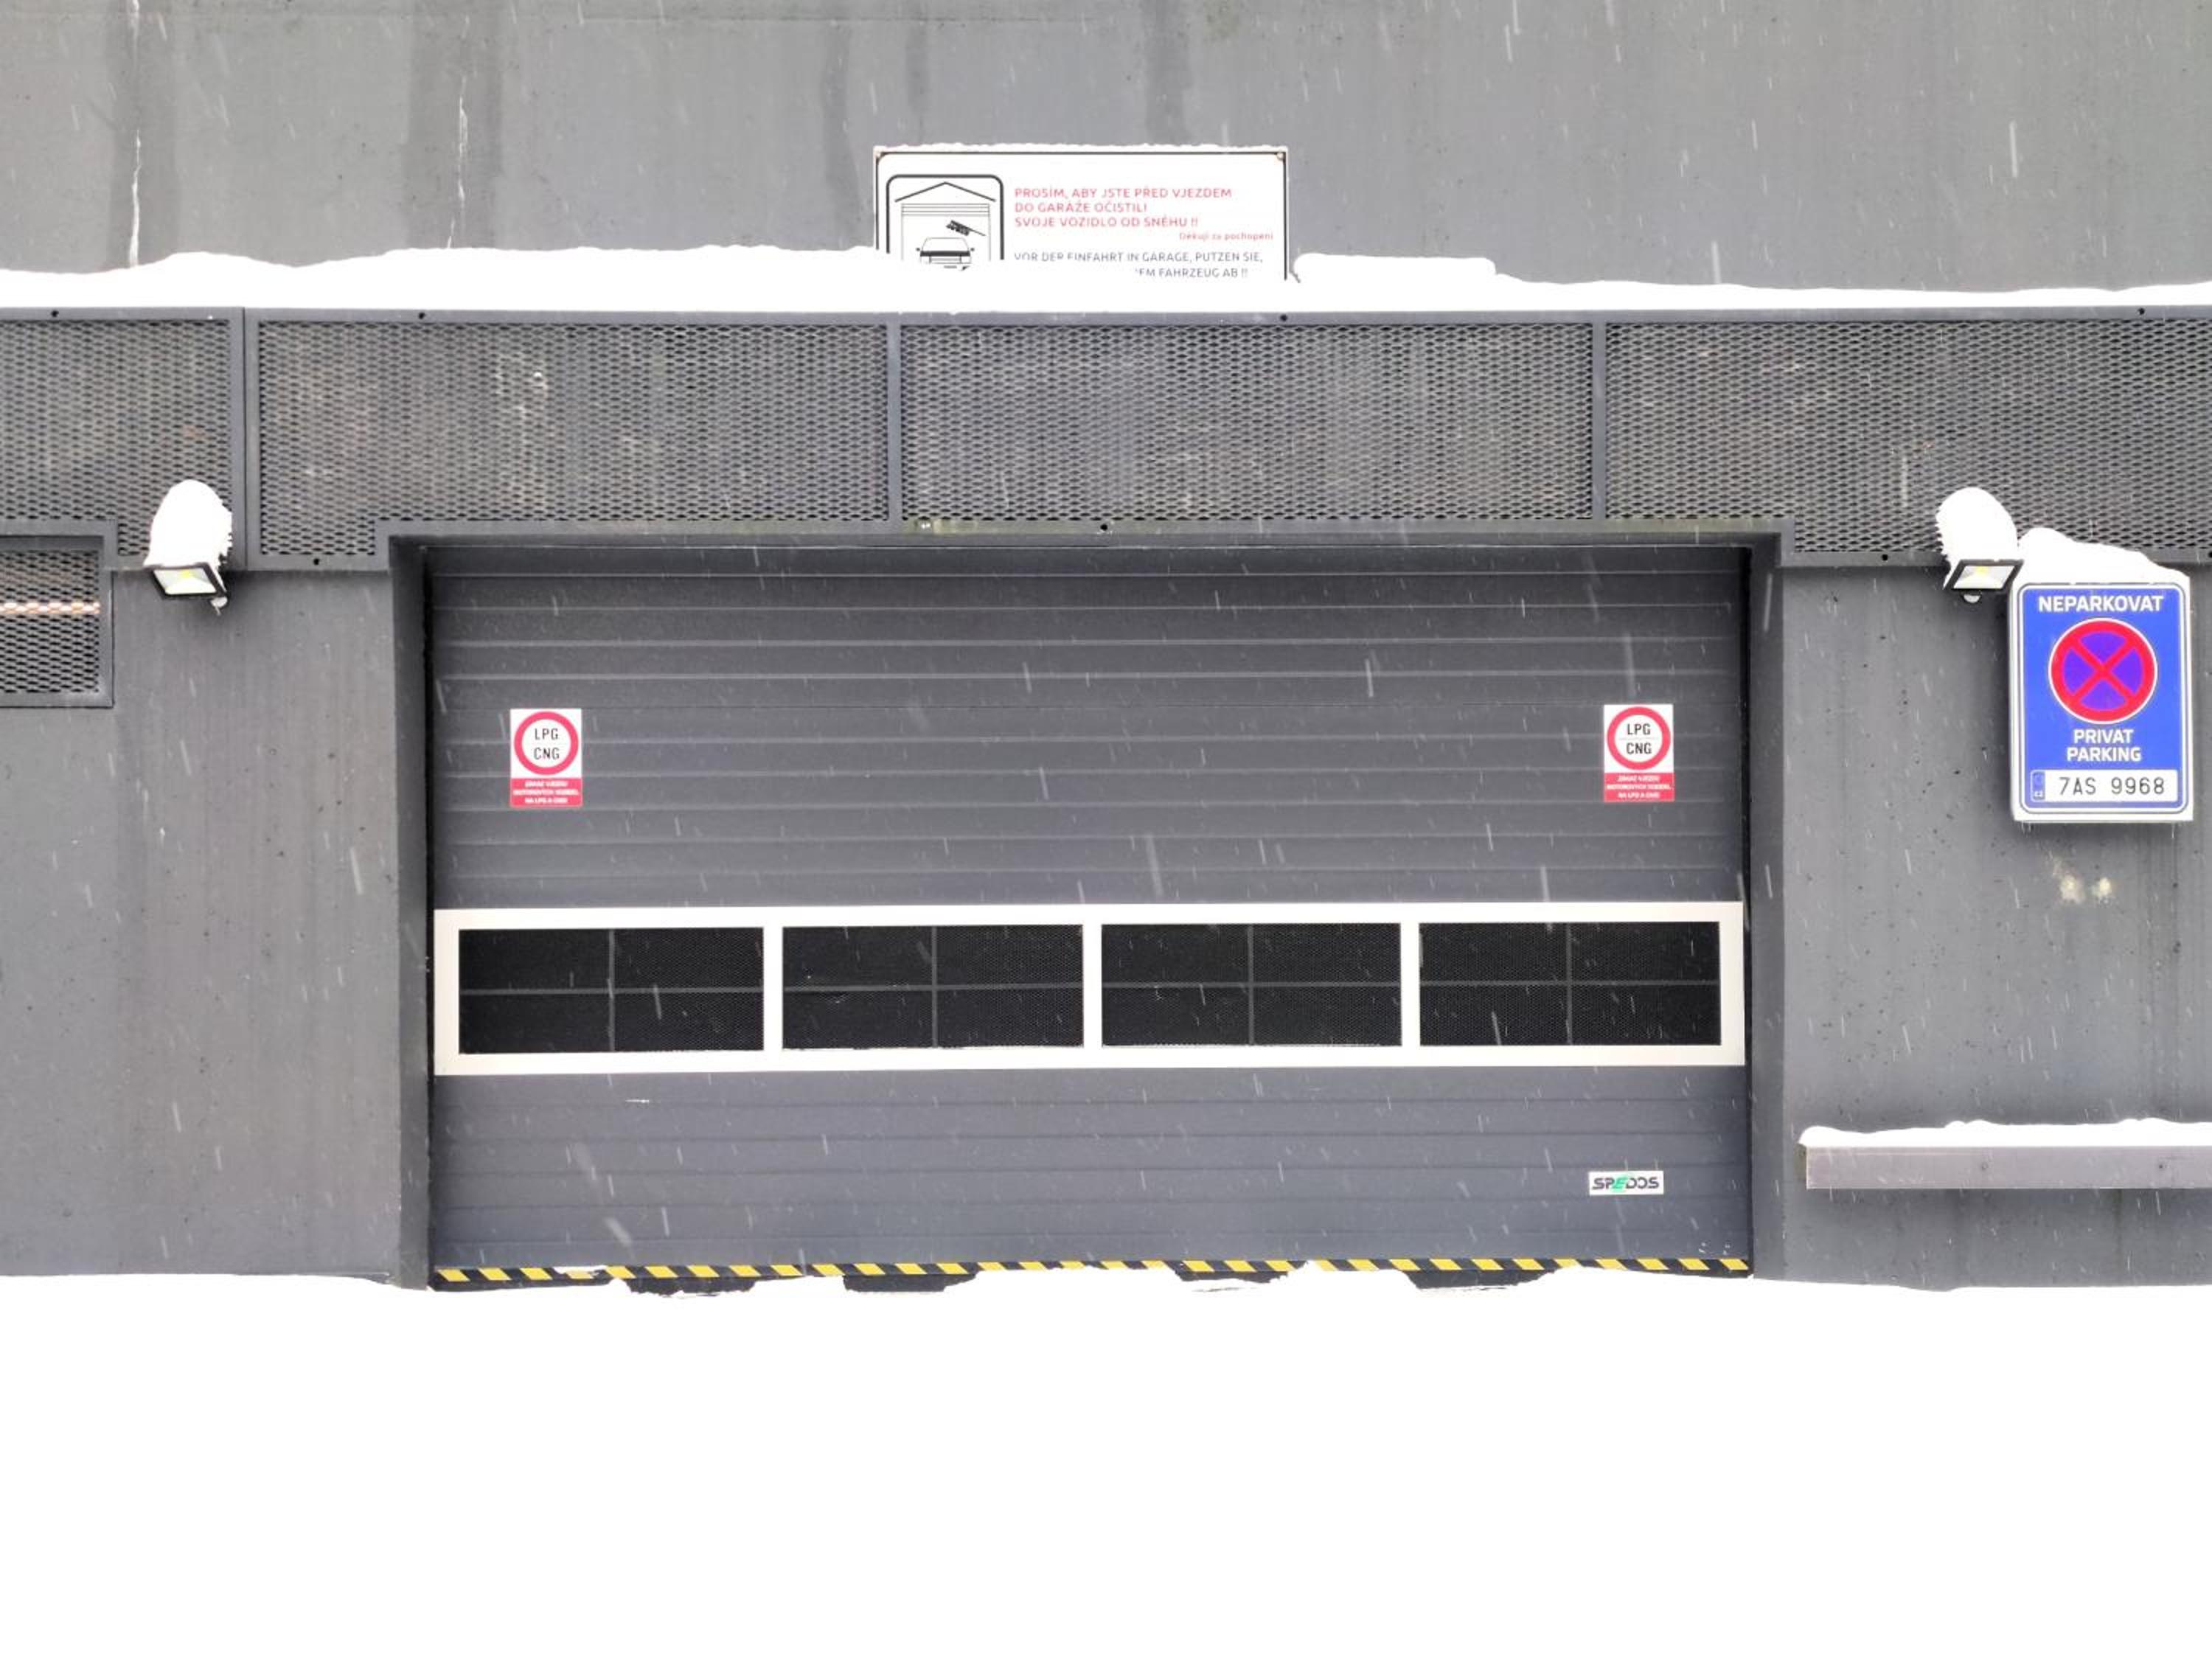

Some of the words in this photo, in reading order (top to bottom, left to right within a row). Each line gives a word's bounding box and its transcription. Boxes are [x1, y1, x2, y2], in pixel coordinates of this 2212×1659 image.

[1015, 185, 1068, 199] PROSÍM,
[1071, 188, 1098, 198] ABY
[1102, 188, 1130, 198] JSTE
[1172, 188, 1232, 198] VJEZDEM
[1015, 203, 1034, 212] DO
[1015, 217, 1055, 228] SVOJE
[1060, 217, 1117, 228] VOZIDLO
[1121, 217, 1141, 228] OD
[1127, 251, 1140, 262] IN
[1142, 251, 1192, 263] GARAGE,
[1195, 251, 1240, 262] PUTZEN
[1243, 251, 1263, 263] SIE,
[1159, 268, 1220, 277] FAHRZEUG
[1222, 268, 1238, 277] AB
[2038, 595, 2164, 613] NEPARKOVAT
[535, 728, 559, 740] LPG
[1627, 723, 1651, 735] LPG
[2073, 728, 2135, 744] PRIVAT
[533, 747, 560, 760] CNG
[1626, 742, 1652, 755] CNG
[2067, 746, 2142, 762] PARKING
[2059, 776, 2097, 796] 7AS
[2111, 776, 2165, 796] 9968
[1591, 1175, 1660, 1191] SPEDOS
